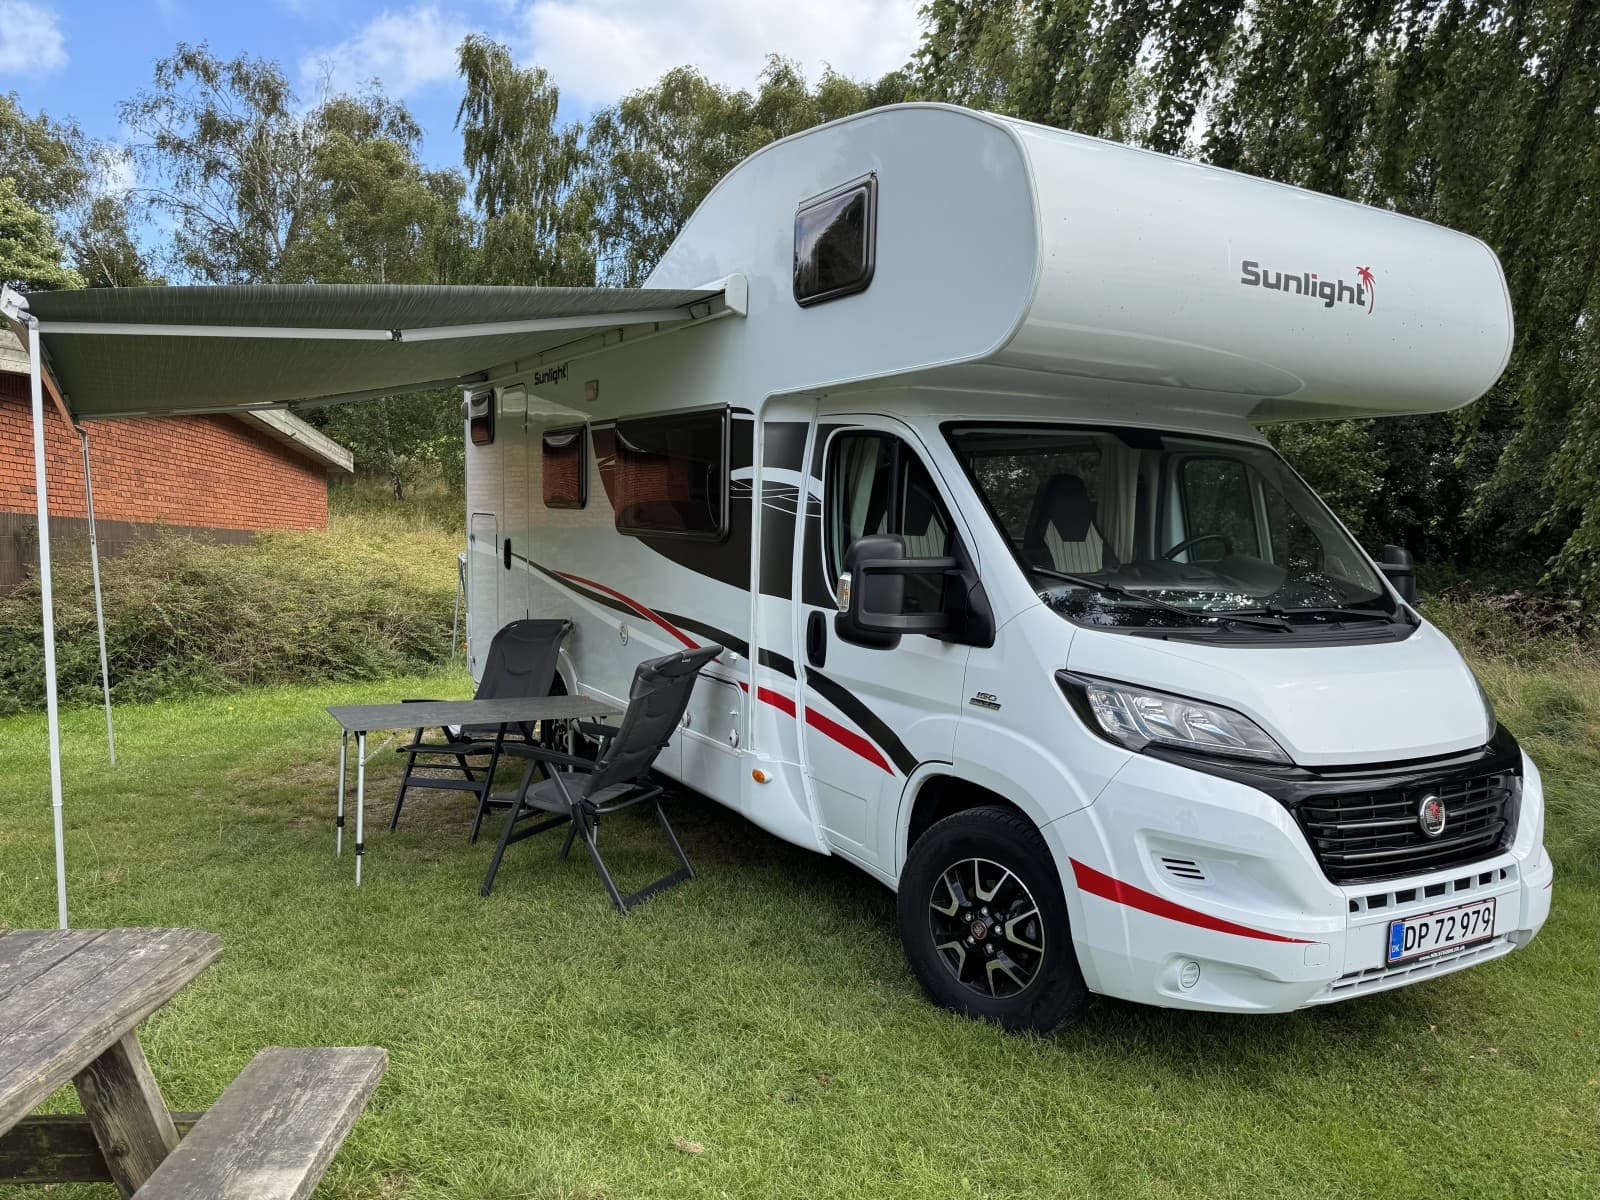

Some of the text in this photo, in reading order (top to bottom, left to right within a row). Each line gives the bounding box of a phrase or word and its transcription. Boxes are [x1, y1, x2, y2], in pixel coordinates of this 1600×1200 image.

[1240, 260, 1366, 308] Sunlight
[534, 365, 567, 385] Sunlight
[1404, 906, 1491, 952] DP 72 979
[1391, 943, 1400, 953] DK
